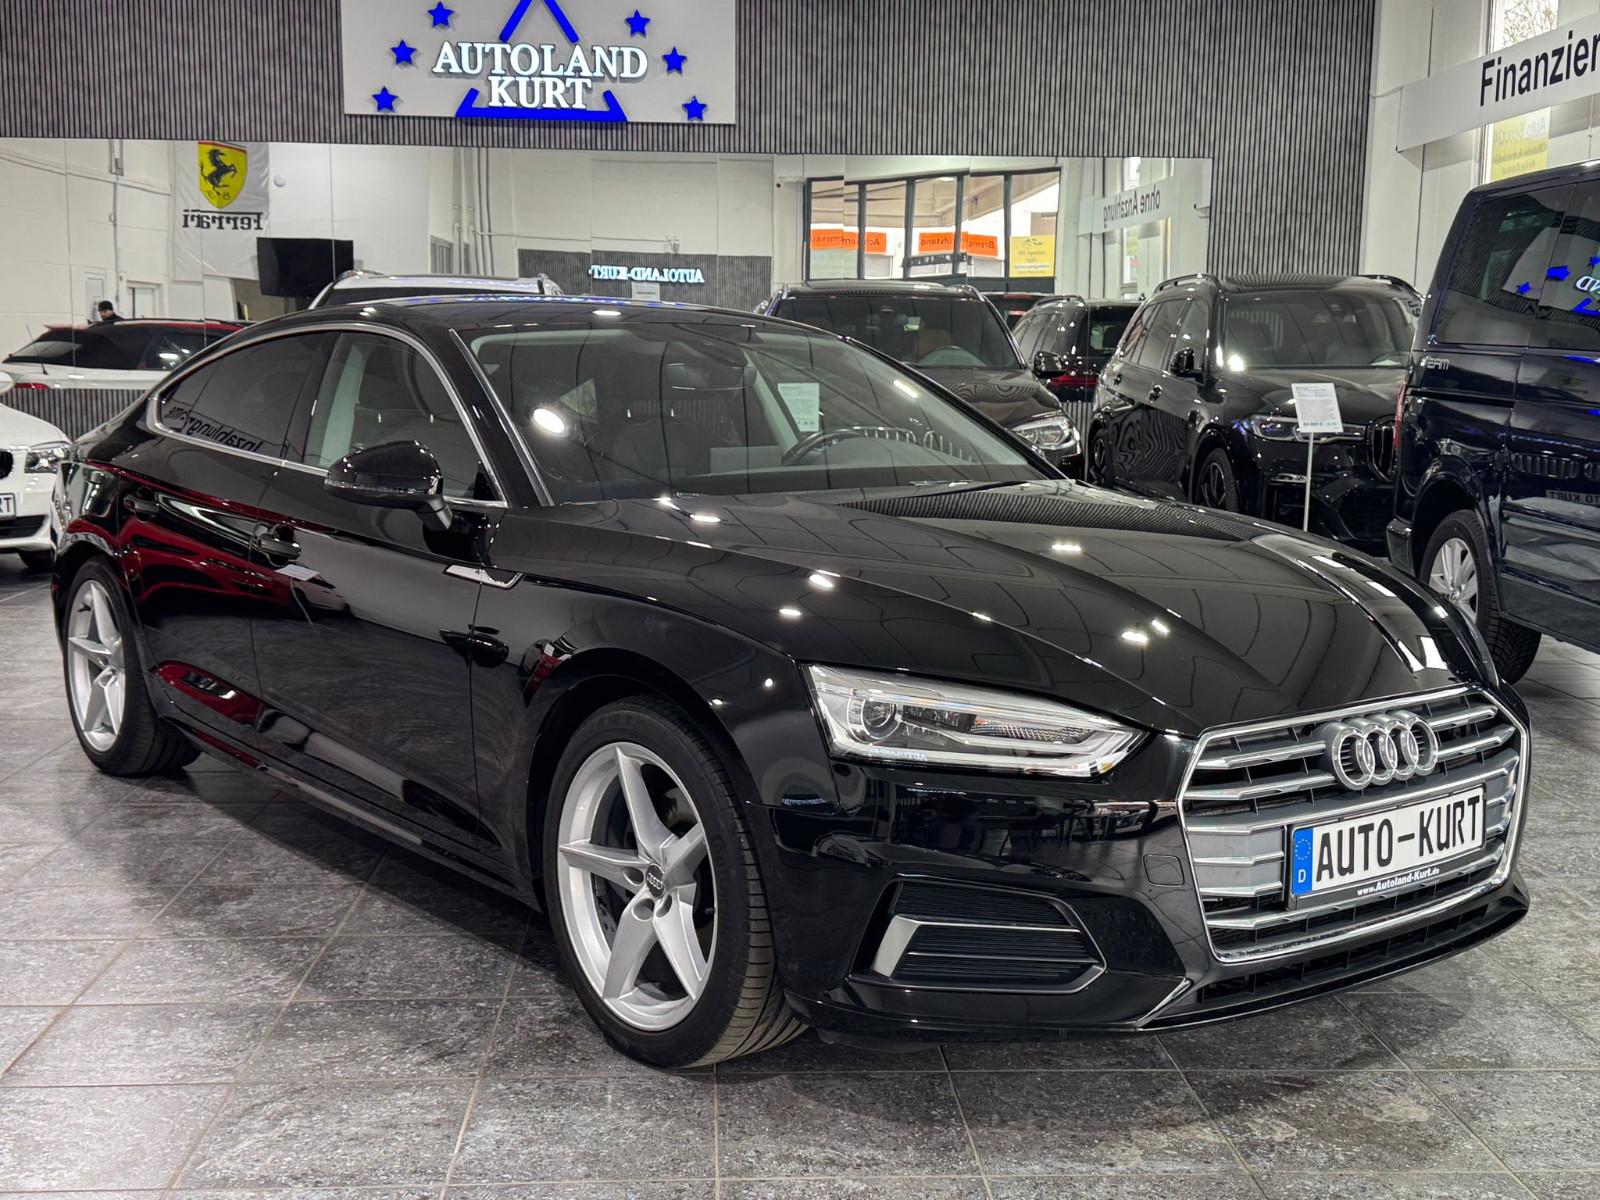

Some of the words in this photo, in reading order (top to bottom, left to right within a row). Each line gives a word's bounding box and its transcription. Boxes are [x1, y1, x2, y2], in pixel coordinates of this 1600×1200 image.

[432, 41, 648, 78] AUTOLAND
[1480, 30, 1600, 107] Finanzier
[487, 75, 592, 109] KURT
[1316, 796, 1479, 882] AUTO-KURT
[1298, 869, 1306, 883] D
[1357, 867, 1440, 896] www.Autoland-Kurt.de
